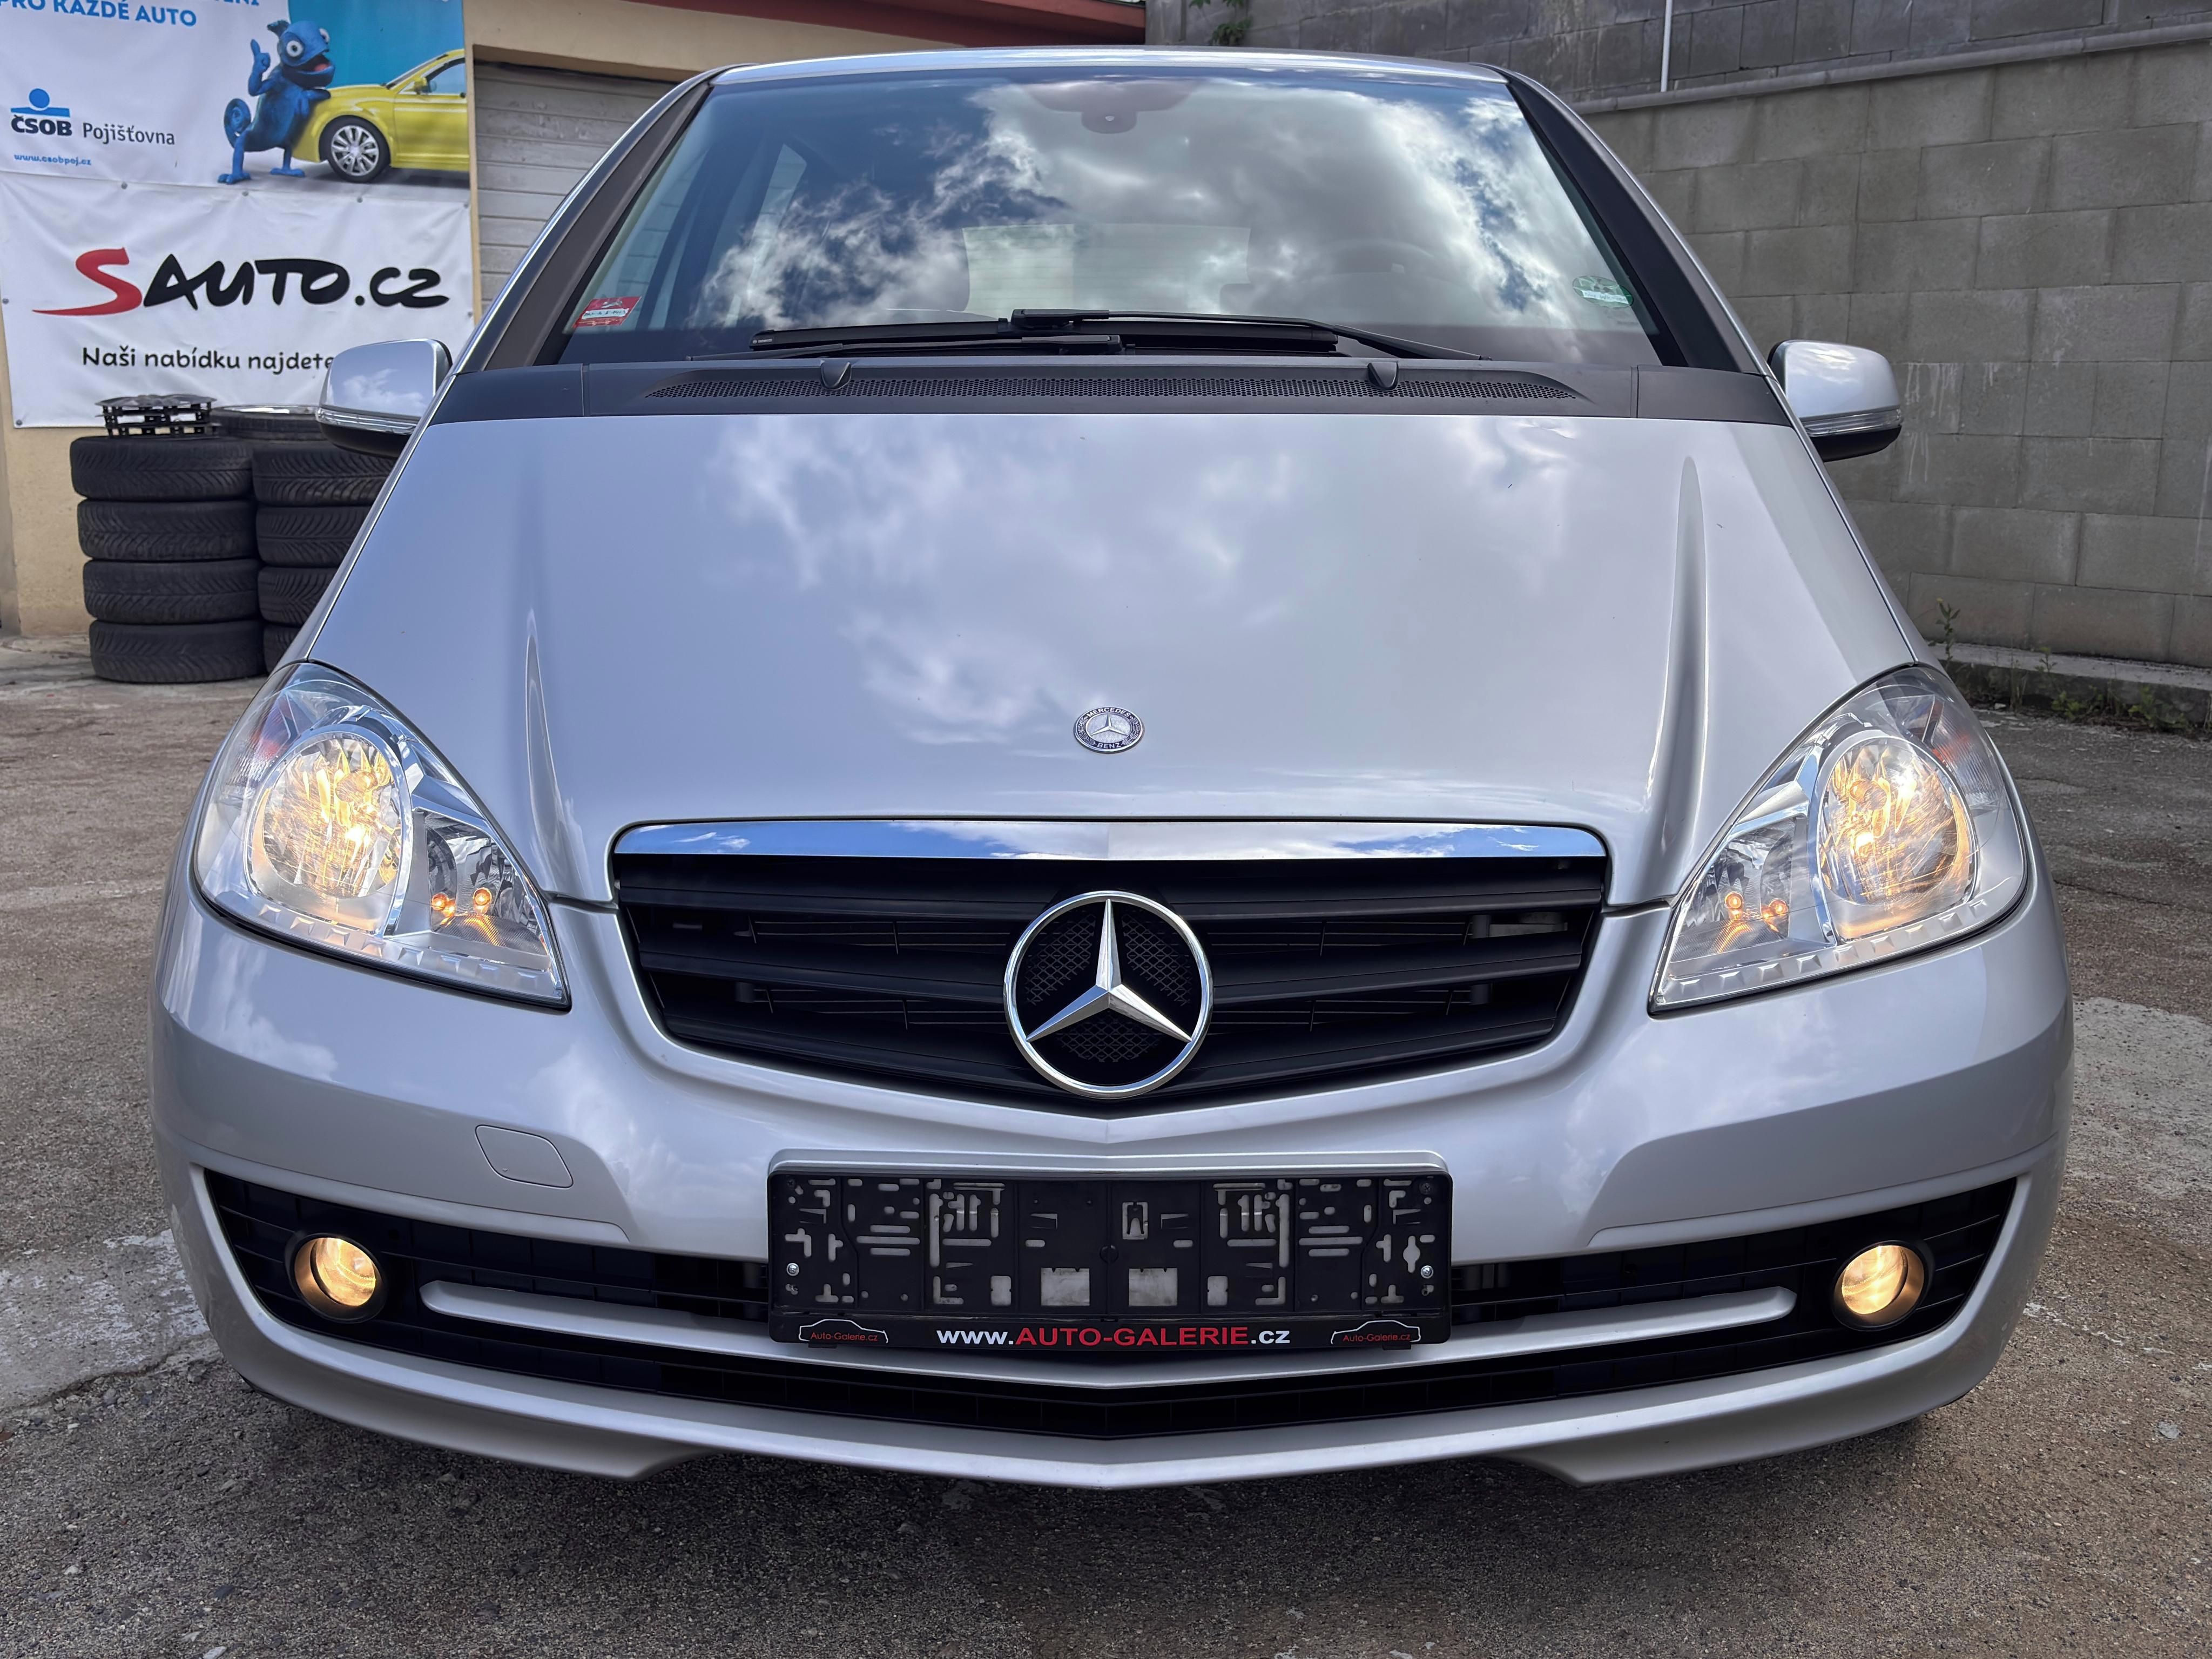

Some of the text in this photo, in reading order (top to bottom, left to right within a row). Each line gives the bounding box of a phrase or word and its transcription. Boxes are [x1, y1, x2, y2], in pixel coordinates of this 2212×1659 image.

[134, 5, 197, 27] AUTO
[11, 114, 175, 145] ČSOB Pojišťovna
[14, 153, 92, 167] www.csobpoj.cz
[83, 345, 136, 367] Naši
[144, 347, 240, 369] nabídku
[1087, 707, 1131, 717] MERCEDES
[810, 1331, 879, 1342] Auto-Galerie.cz
[936, 1327, 1291, 1346] www.AUTO-GALERIE.cz
[1343, 1333, 1411, 1343] Auto-Galerie.cz
